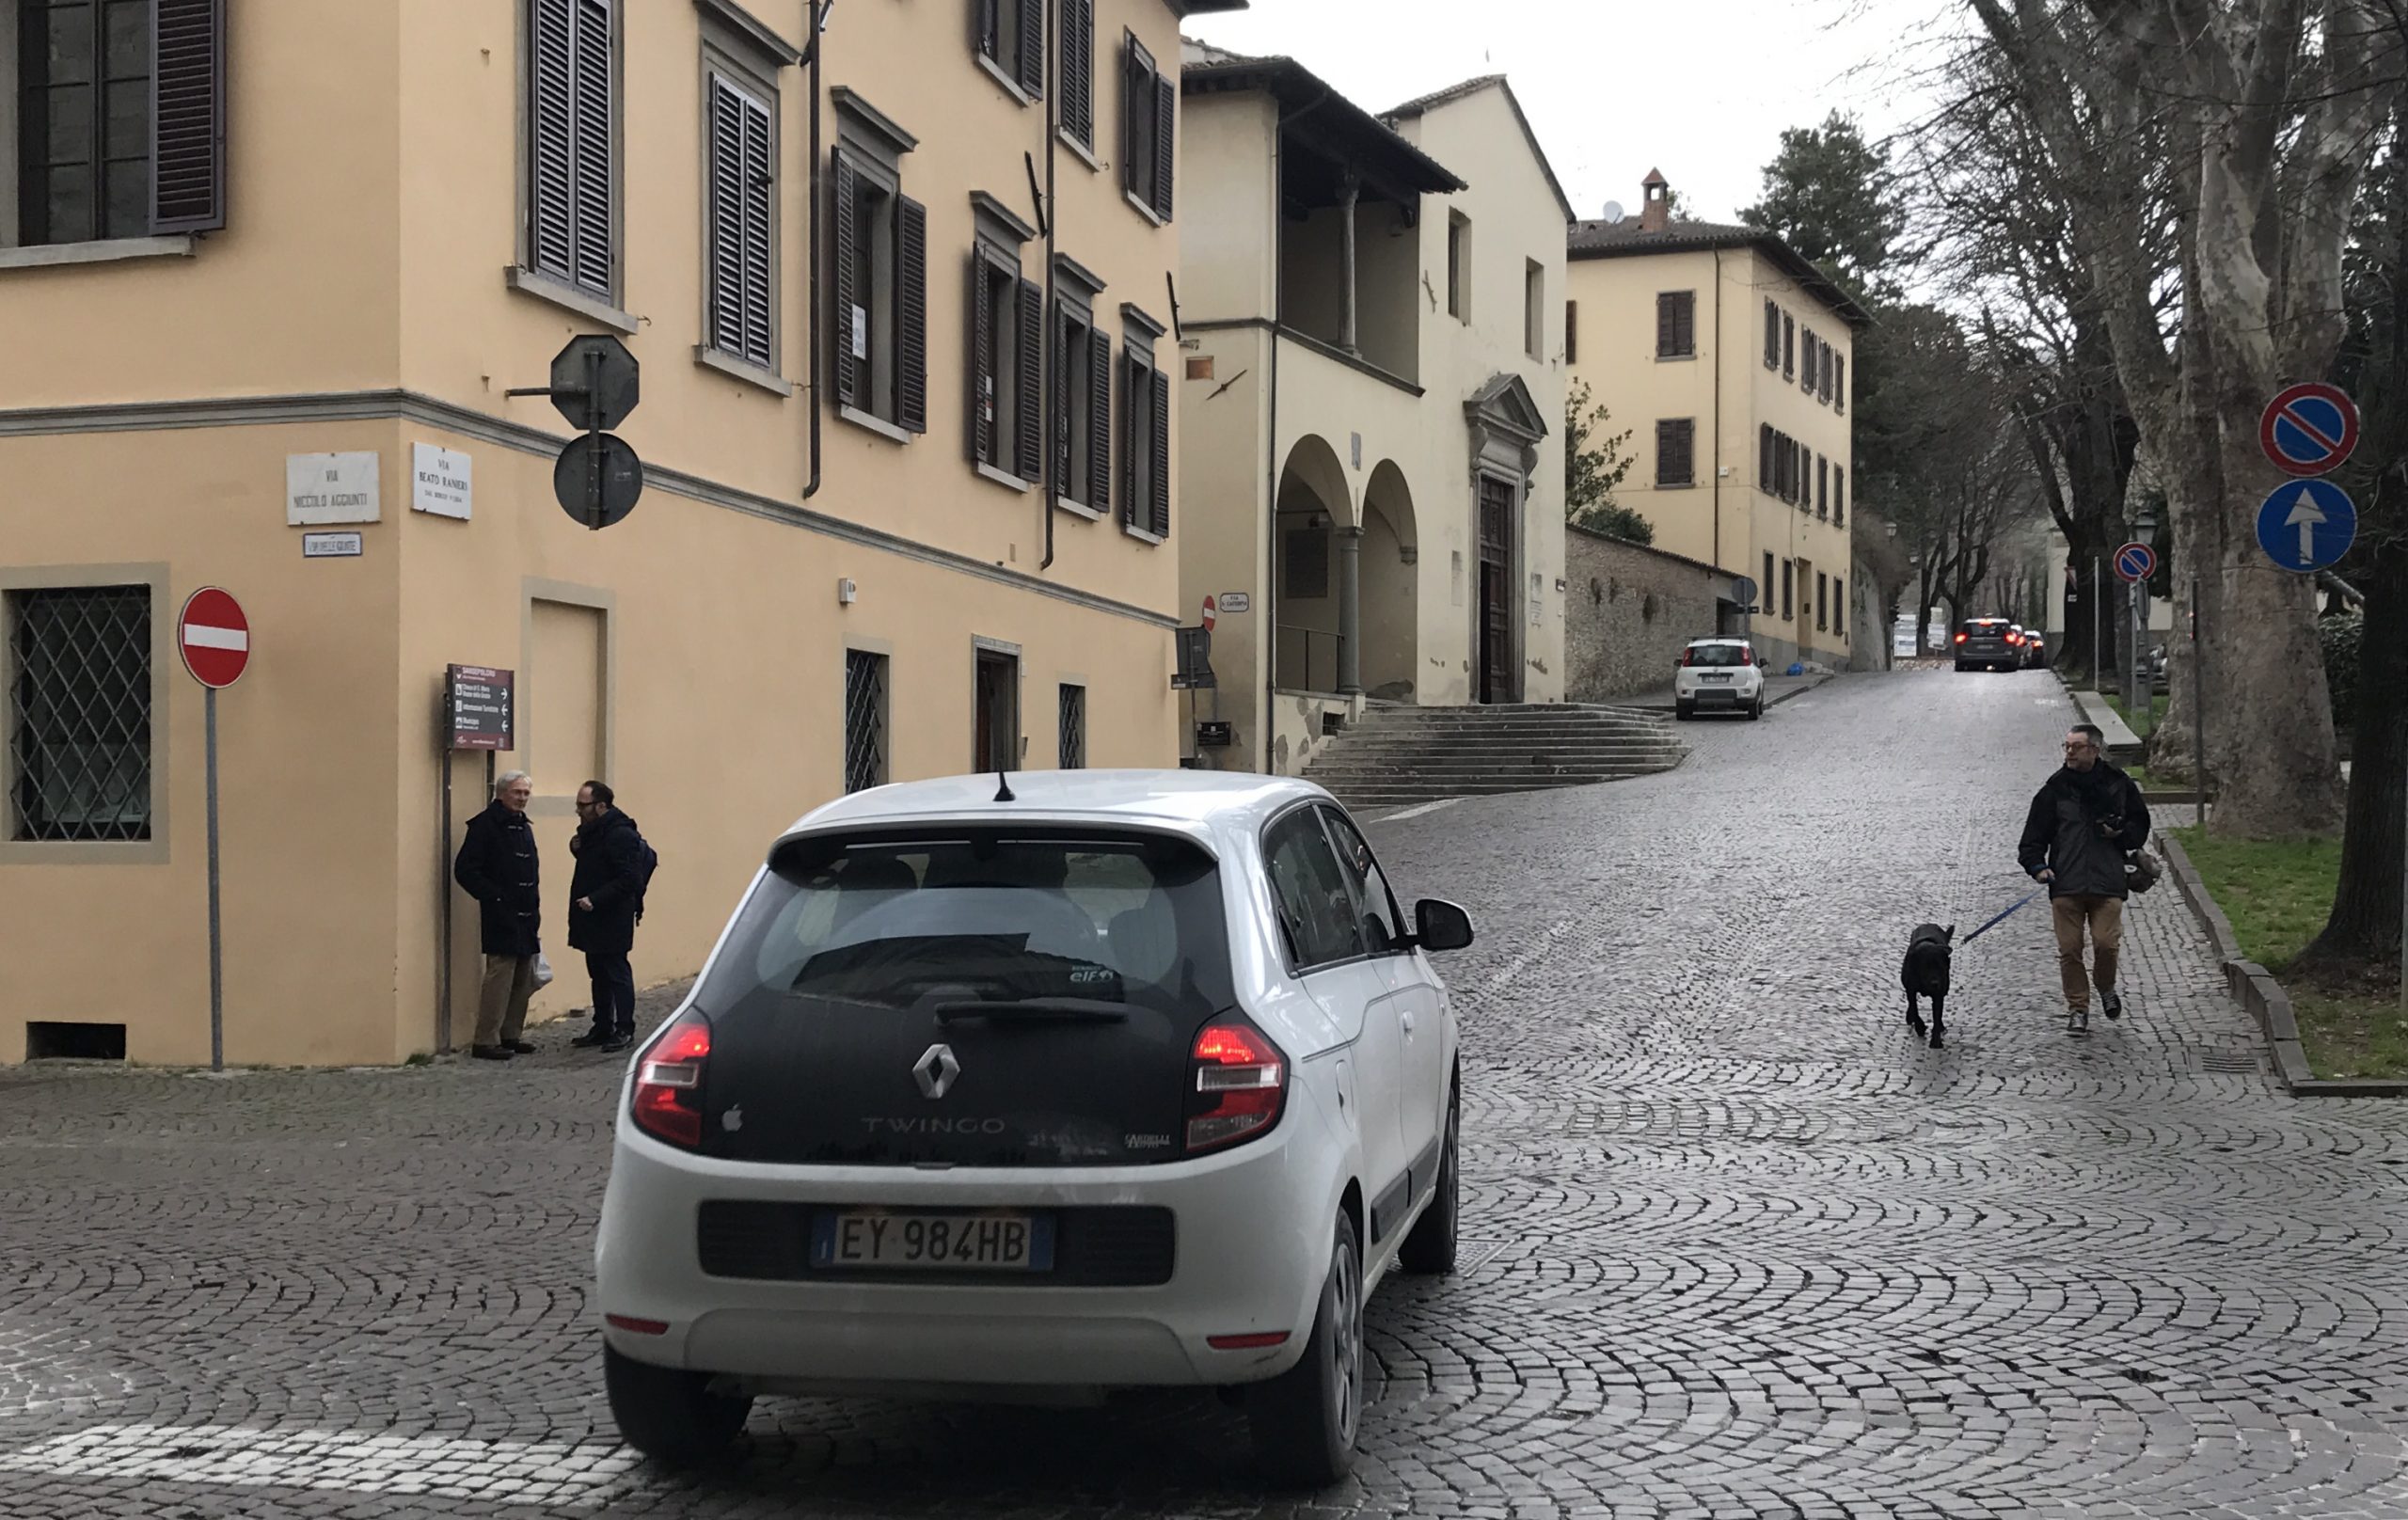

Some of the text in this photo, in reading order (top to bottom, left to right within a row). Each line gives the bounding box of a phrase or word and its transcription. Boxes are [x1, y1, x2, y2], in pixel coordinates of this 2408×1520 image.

[438, 458, 450, 470] VIA
[325, 469, 339, 482] VIA
[419, 471, 468, 491] BEATO RANIERI
[331, 493, 368, 506] AGGIUNTI
[861, 1117, 1006, 1134] TWINGO
[840, 1218, 1026, 1262] EY 984HB
